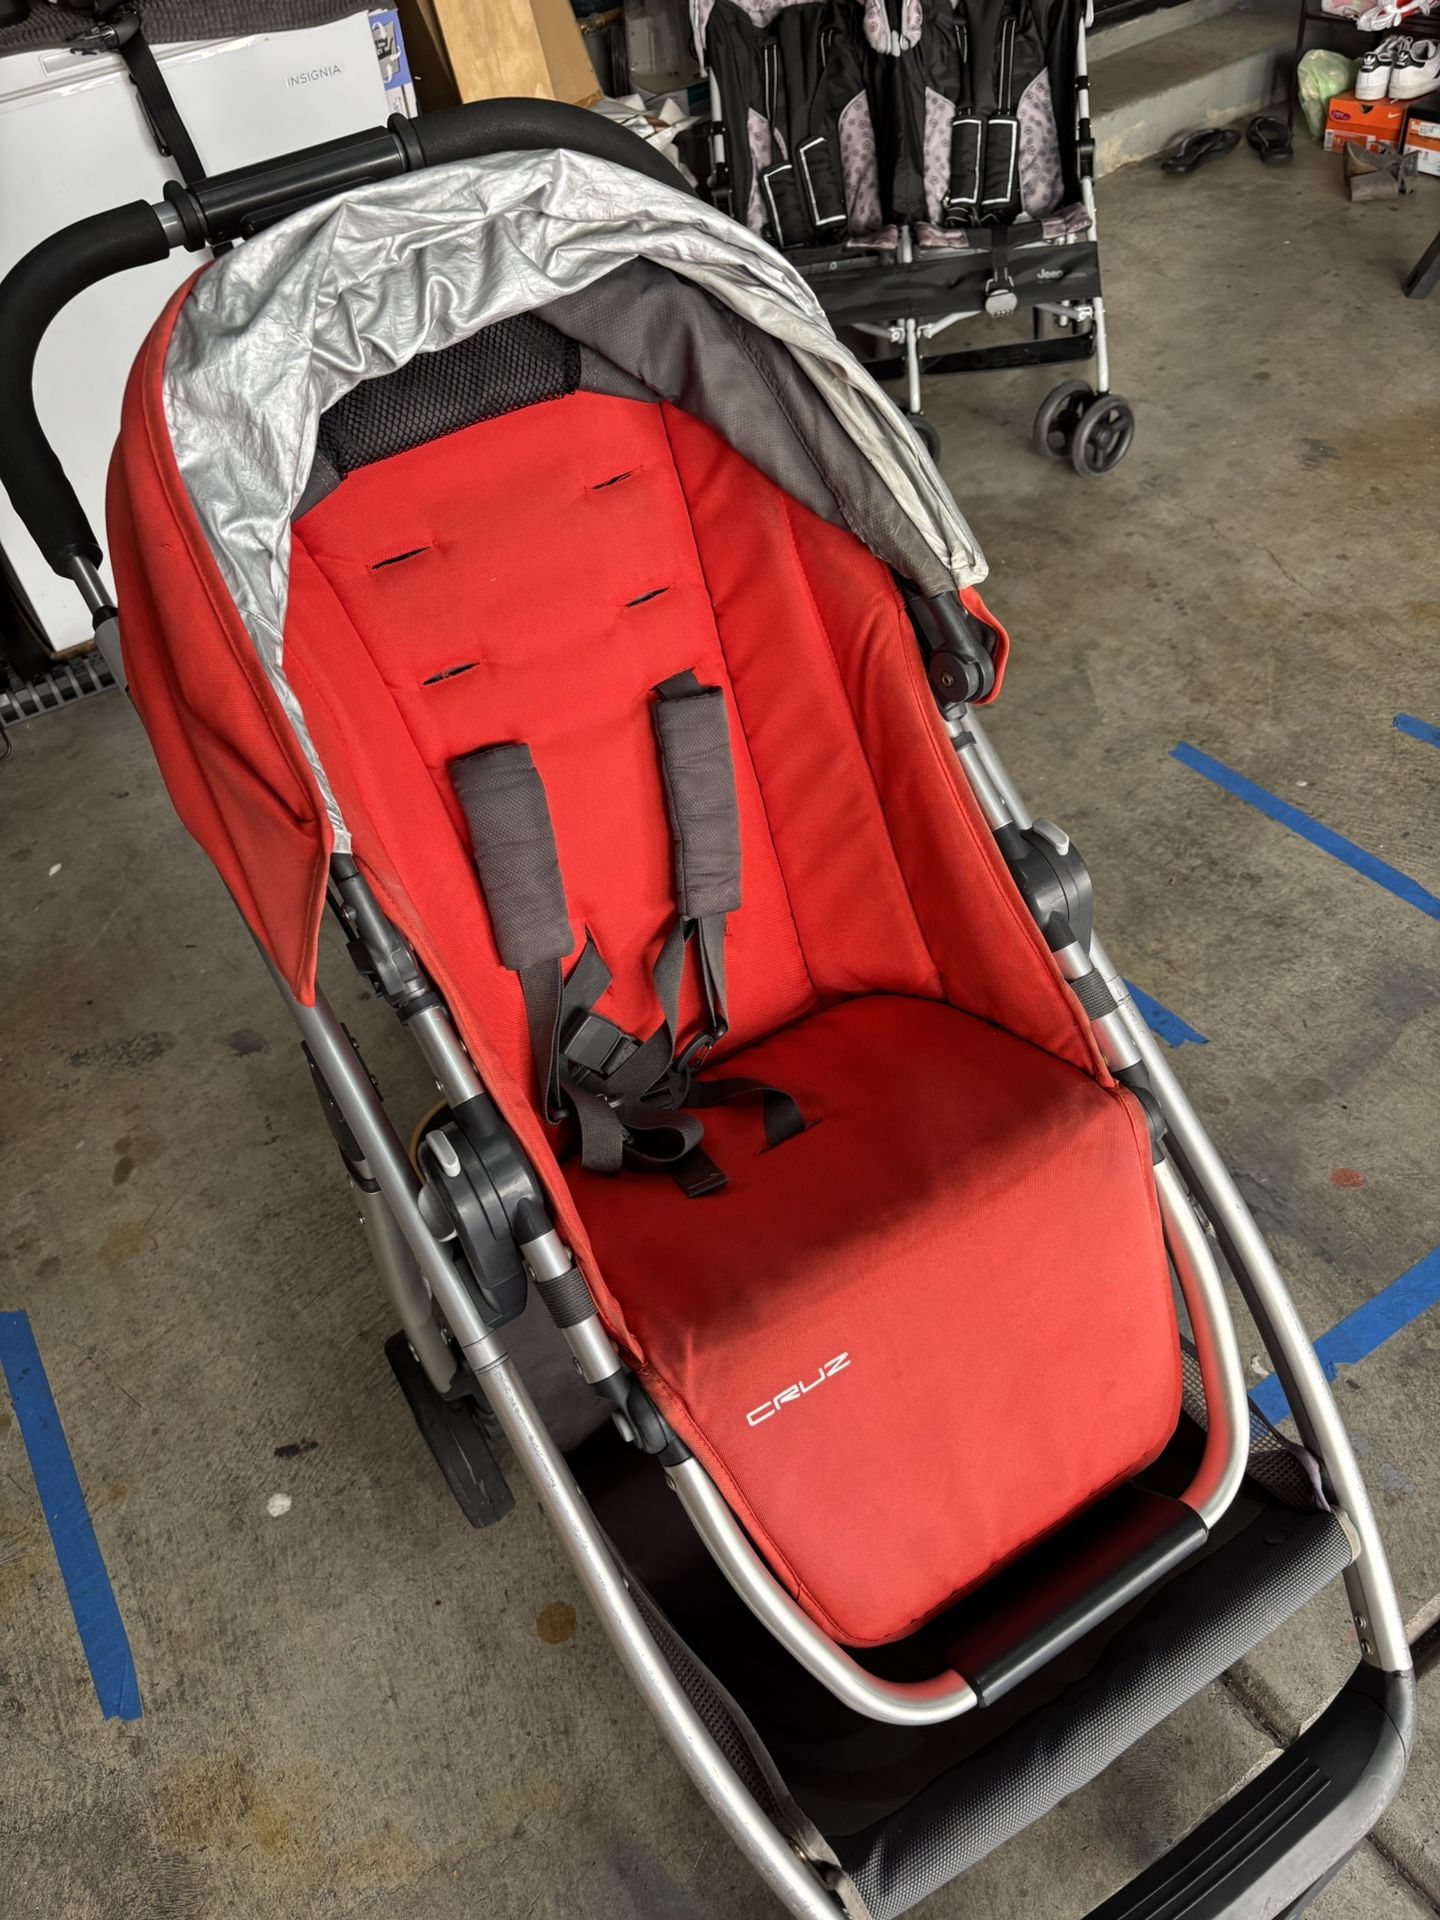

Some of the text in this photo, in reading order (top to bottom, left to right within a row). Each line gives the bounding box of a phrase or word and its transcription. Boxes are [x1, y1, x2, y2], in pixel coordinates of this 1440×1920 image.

[286, 64, 342, 87] INSIGNIA
[1036, 268, 1064, 279] Jeep
[746, 1352, 851, 1426] CRUZ
